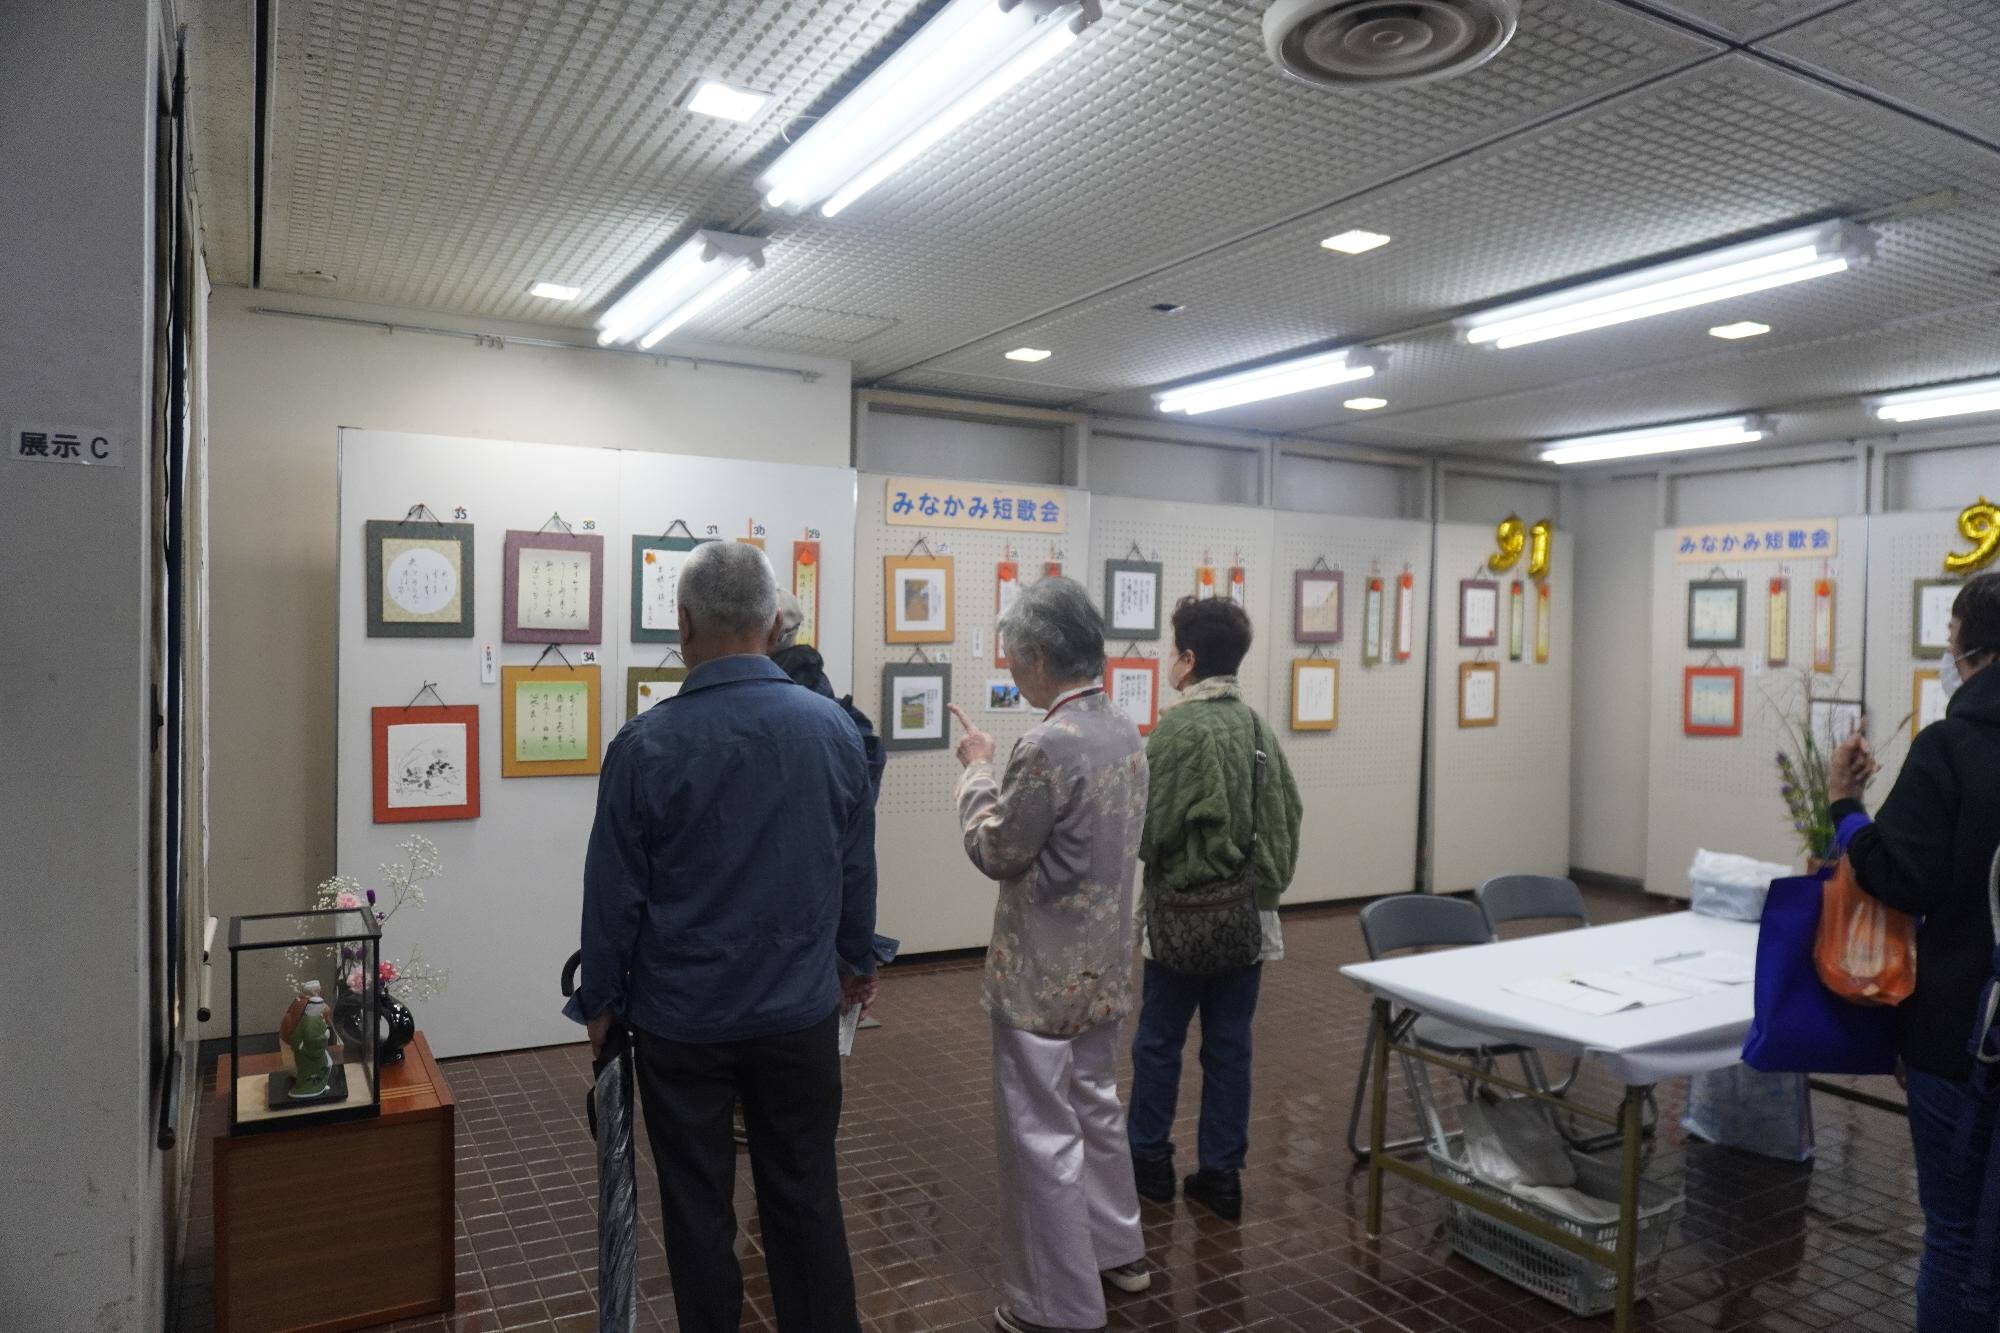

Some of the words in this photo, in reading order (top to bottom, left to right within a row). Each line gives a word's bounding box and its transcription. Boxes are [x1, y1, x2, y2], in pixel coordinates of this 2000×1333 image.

[19, 432, 80, 458] 展示
[91, 437, 109, 459] C
[892, 492, 1060, 523] みなかみ短歌会
[1680, 529, 1830, 554] みなかみ短歌会
[583, 651, 595, 662] 34
